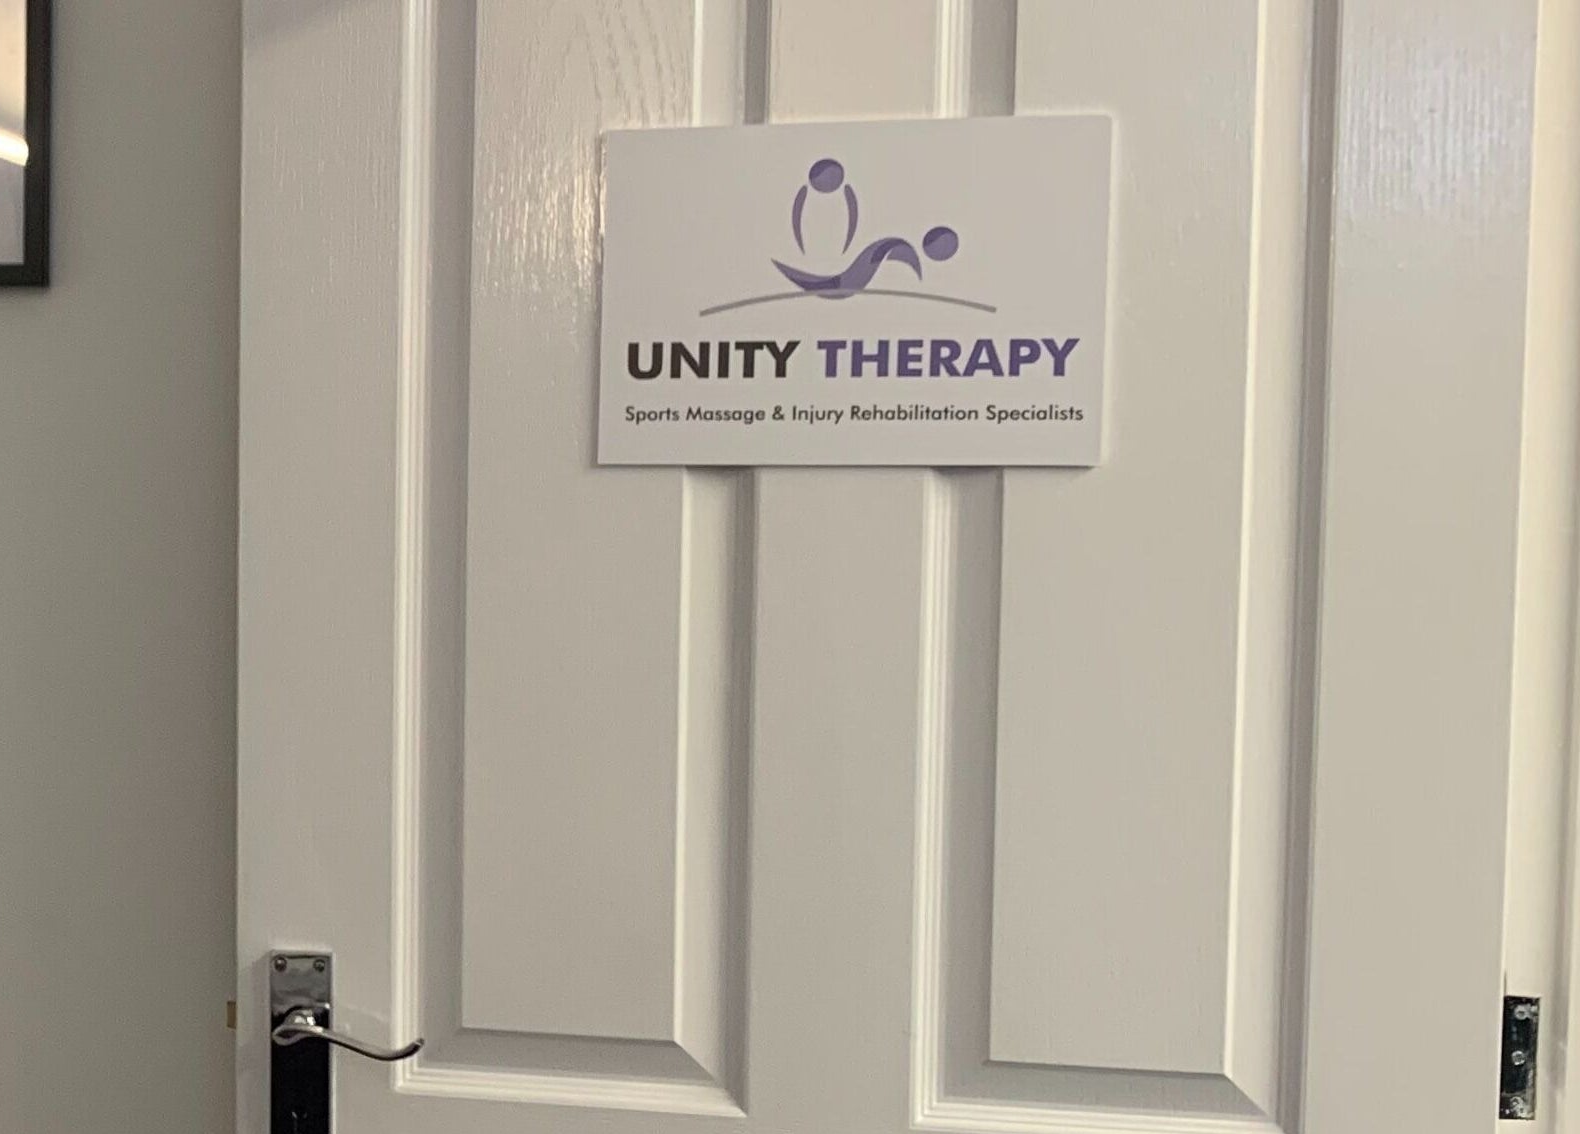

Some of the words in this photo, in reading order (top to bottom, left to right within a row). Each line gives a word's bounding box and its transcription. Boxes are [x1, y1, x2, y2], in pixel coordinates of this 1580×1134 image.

[627, 340, 801, 379] UNITY
[817, 338, 1081, 378] THERAPY
[625, 405, 680, 424] Sports
[686, 406, 766, 424] Massage
[772, 405, 785, 421] &
[792, 405, 844, 425] Injury
[850, 404, 979, 421] Rehabilitation
[986, 404, 1084, 424] Specialists
